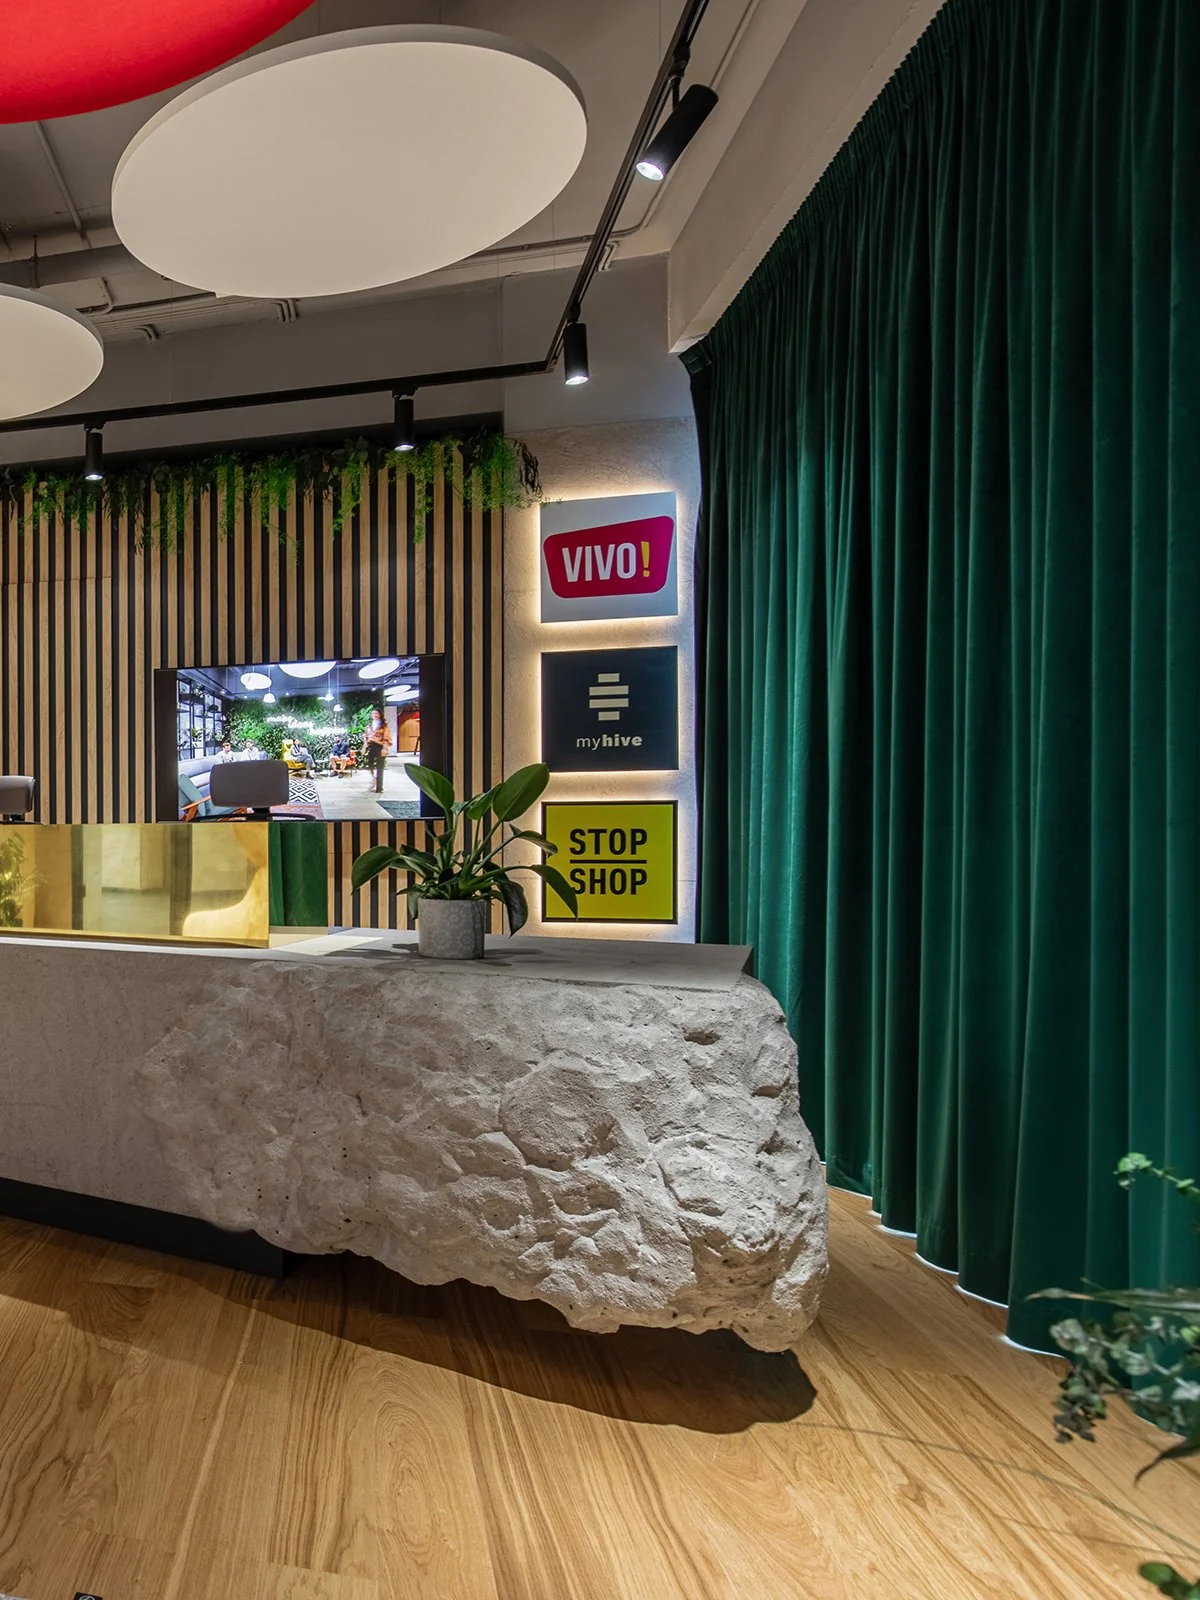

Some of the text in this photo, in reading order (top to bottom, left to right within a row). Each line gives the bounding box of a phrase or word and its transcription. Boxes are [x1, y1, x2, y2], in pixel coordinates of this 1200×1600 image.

[562, 541, 650, 582] VIVO!
[576, 734, 643, 751] myhive
[569, 828, 647, 855] STOP
[569, 868, 647, 895] SHOP
